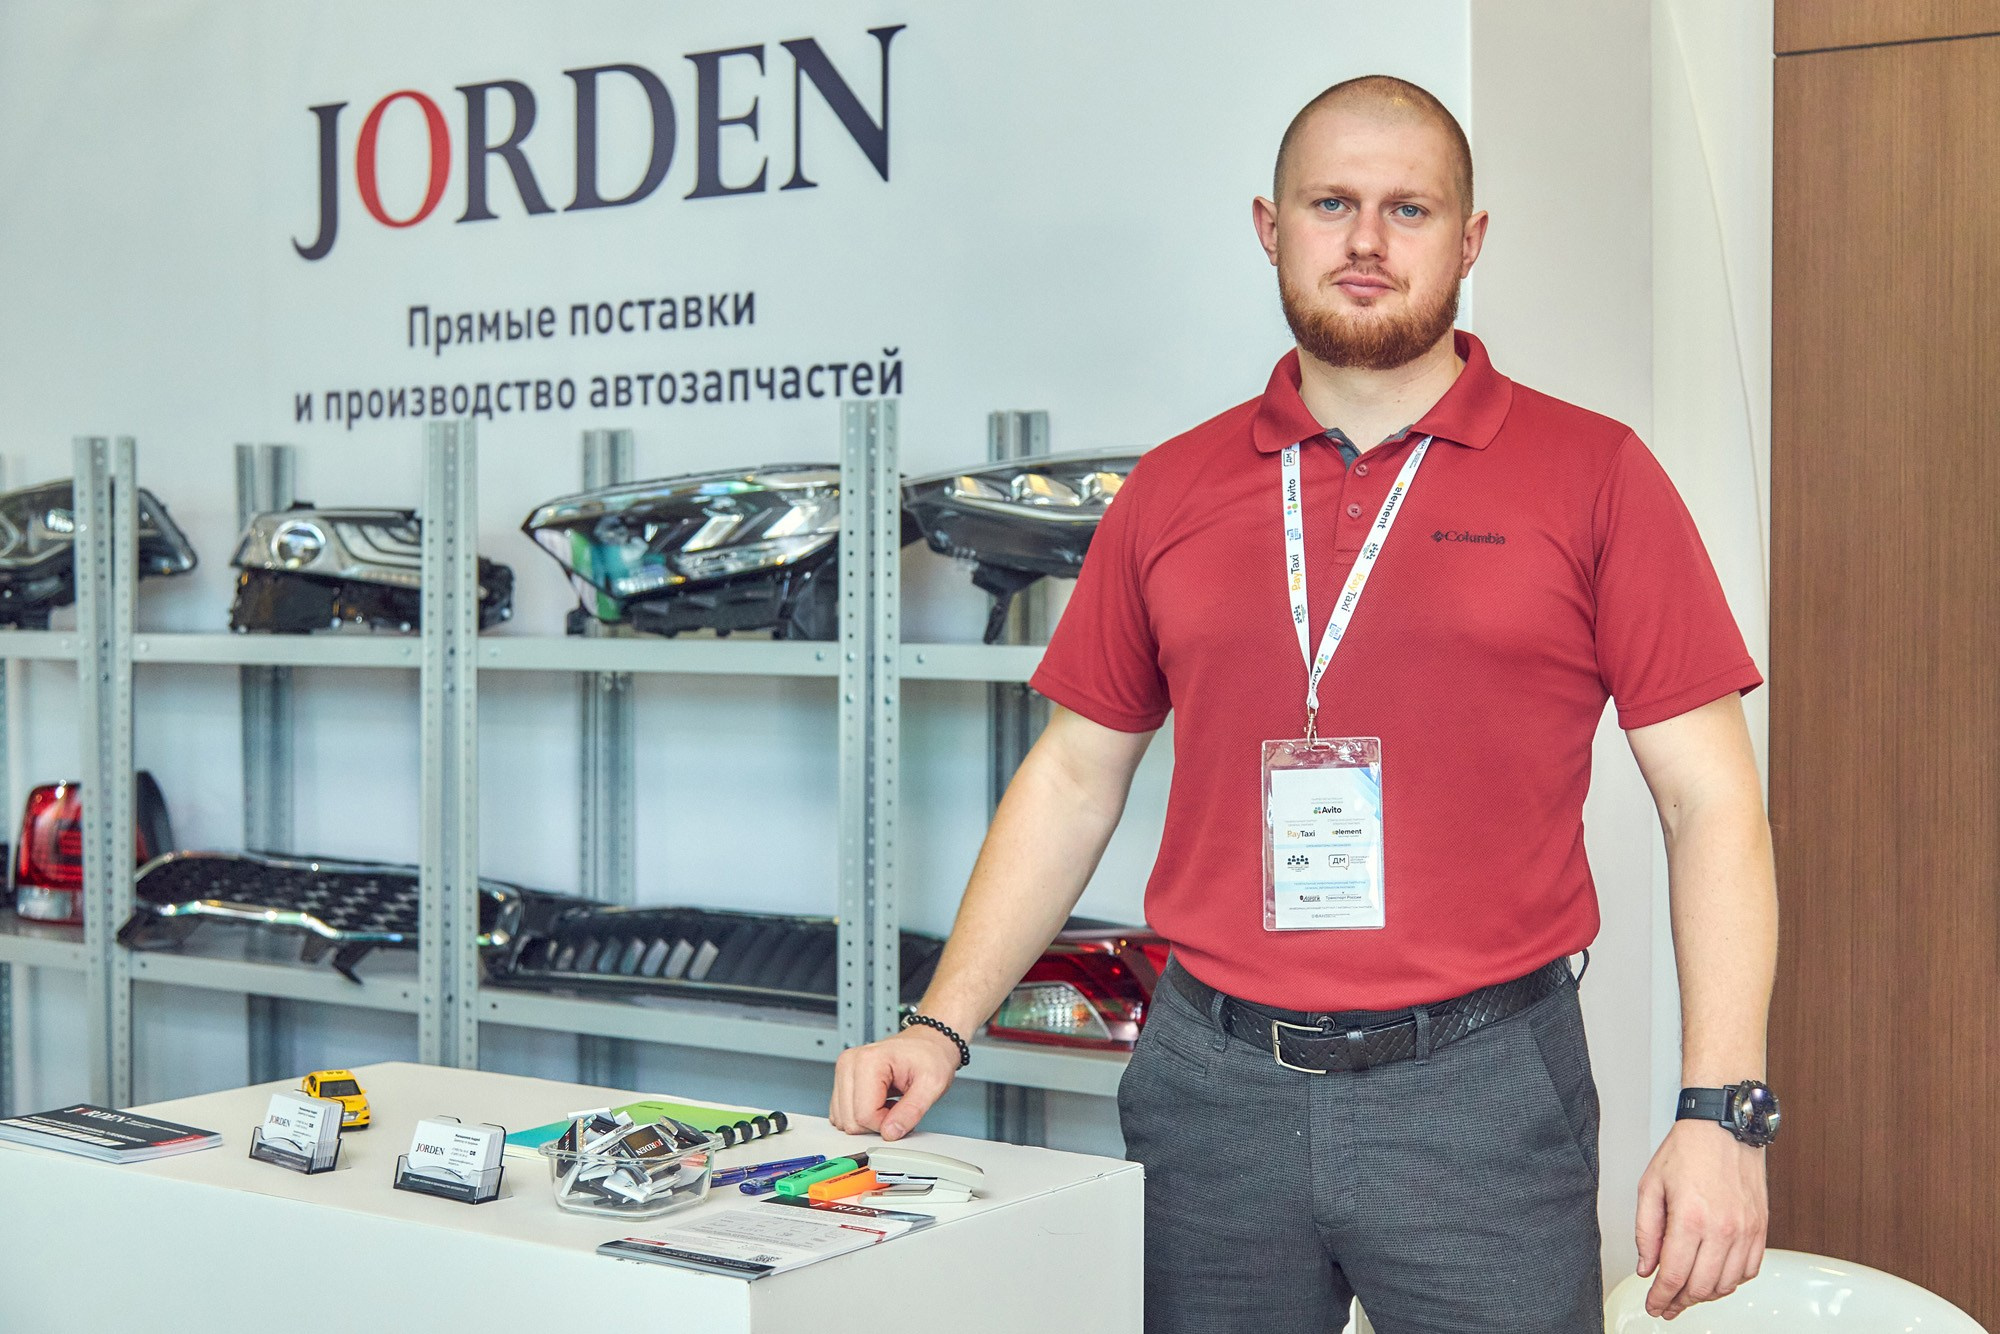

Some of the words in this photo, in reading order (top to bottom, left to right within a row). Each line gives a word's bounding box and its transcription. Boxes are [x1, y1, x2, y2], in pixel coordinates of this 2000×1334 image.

[291, 24, 907, 262] JORDEN
[407, 304, 556, 356] Прямые
[569, 291, 756, 337] поставки
[294, 392, 313, 423] и
[325, 376, 577, 430] производство
[589, 346, 903, 411] автозапчастей
[1287, 478, 1297, 502] Avito
[1377, 486, 1403, 530] element
[1444, 530, 1506, 545] Columbia
[1321, 806, 1342, 814] Avito
[268, 1114, 292, 1128] JORDEN
[415, 1142, 446, 1156] JORDEN
[635, 1138, 664, 1155] JORDEN
[809, 1202, 887, 1215] JRDEN
